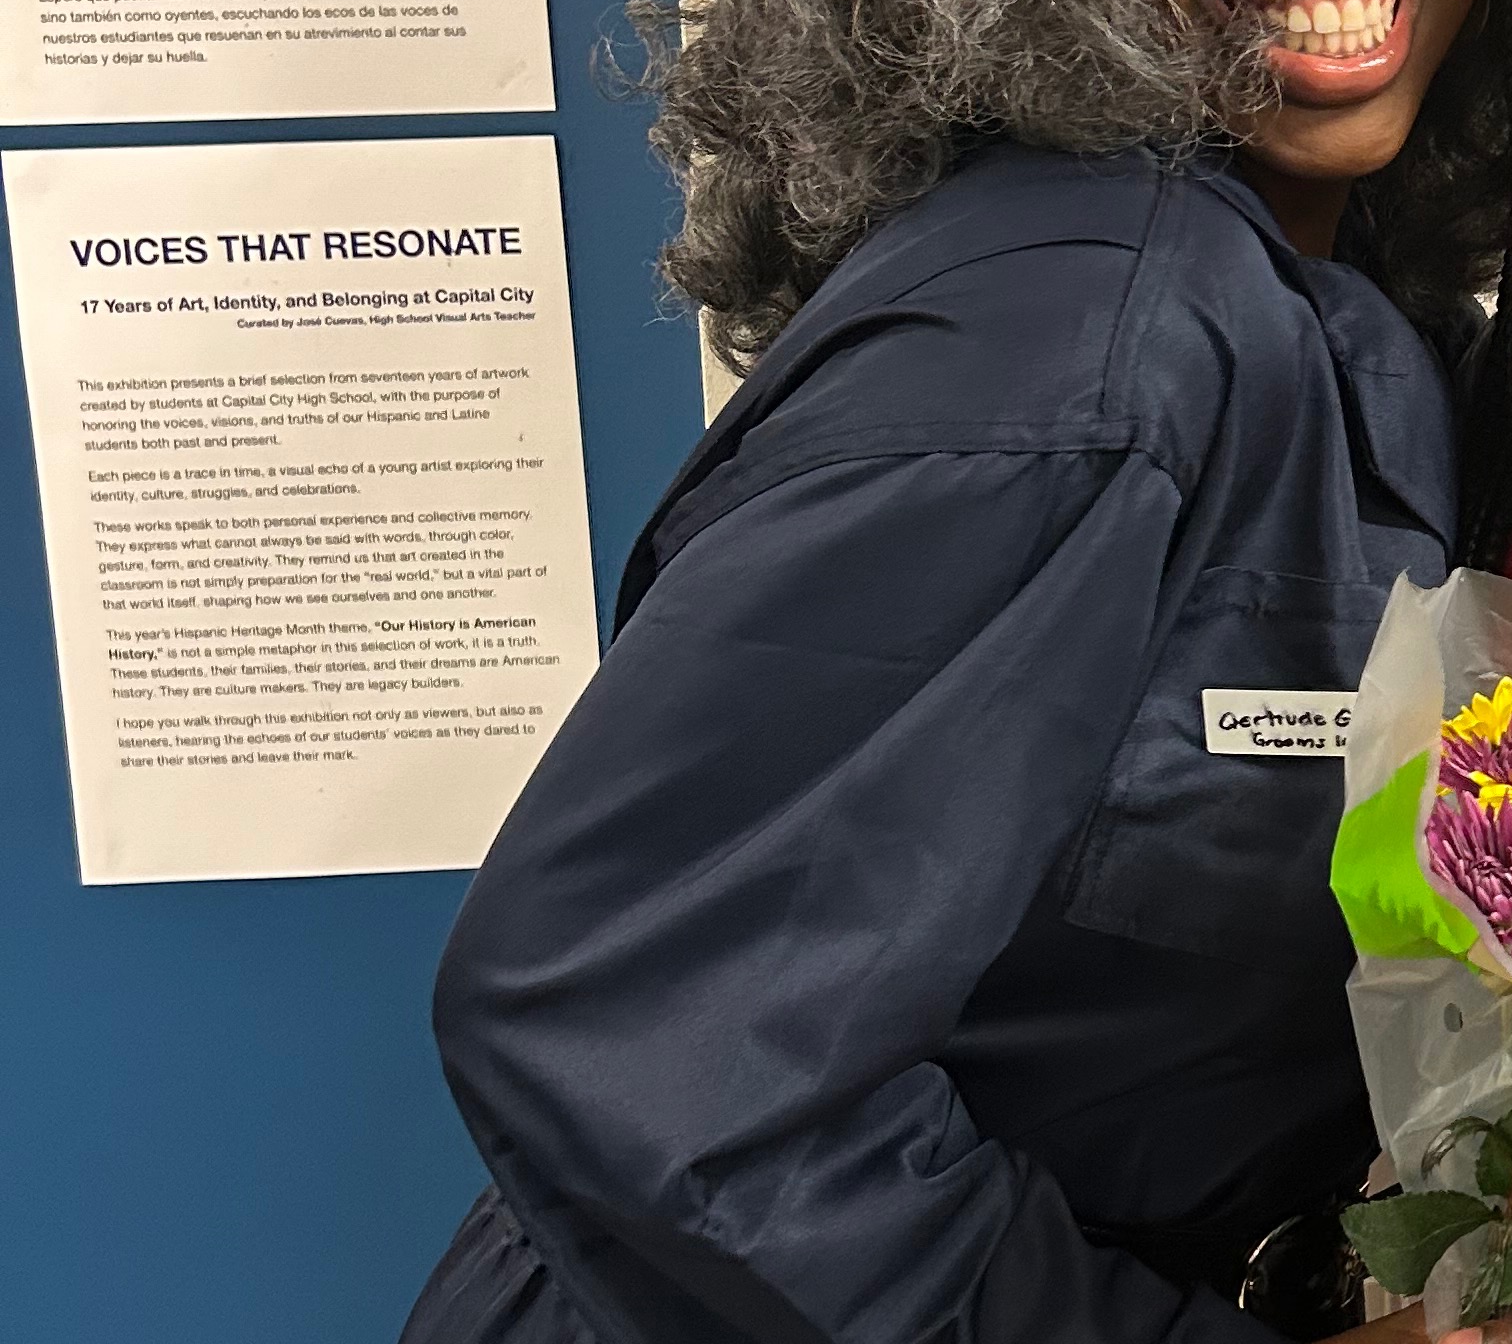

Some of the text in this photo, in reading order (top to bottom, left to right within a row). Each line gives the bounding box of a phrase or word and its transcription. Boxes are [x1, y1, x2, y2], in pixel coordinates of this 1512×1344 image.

[44, 53, 98, 65] historias
[101, 54, 108, 66] y
[111, 51, 143, 65] dejar
[147, 53, 162, 63] su
[69, 227, 522, 267] VOICES THAT RESONATE
[81, 286, 534, 313] 17 Years of Art, Identity, and Belonging at Capital City
[77, 366, 529, 391] This exhibition presents a brief selection from seventeen years of artwork
[79, 398, 126, 411] created
[130, 399, 145, 412] by
[149, 397, 203, 409] students
[206, 397, 218, 407] at
[221, 394, 266, 408] Capital
[269, 393, 294, 408] City
[297, 393, 326, 407] High
[380, 391, 406, 402] with
[409, 390, 430, 401] the
[433, 390, 485, 403] purpose
[487, 386, 500, 399] of
[93, 521, 131, 533] These
[135, 520, 171, 532] works
[174, 518, 212, 532] speak
[215, 518, 228, 529] to
[231, 517, 260, 529] both
[263, 514, 316, 528] personal
[319, 514, 387, 527] experience
[390, 511, 414, 523] and
[417, 510, 476, 523] collective
[1219, 707, 1327, 731] Gertrude
[120, 756, 153, 767] share
[157, 754, 184, 766] their
[187, 754, 228, 765] stories
[231, 751, 254, 764] and
[257, 751, 289, 763] leave
[293, 750, 319, 761] their
